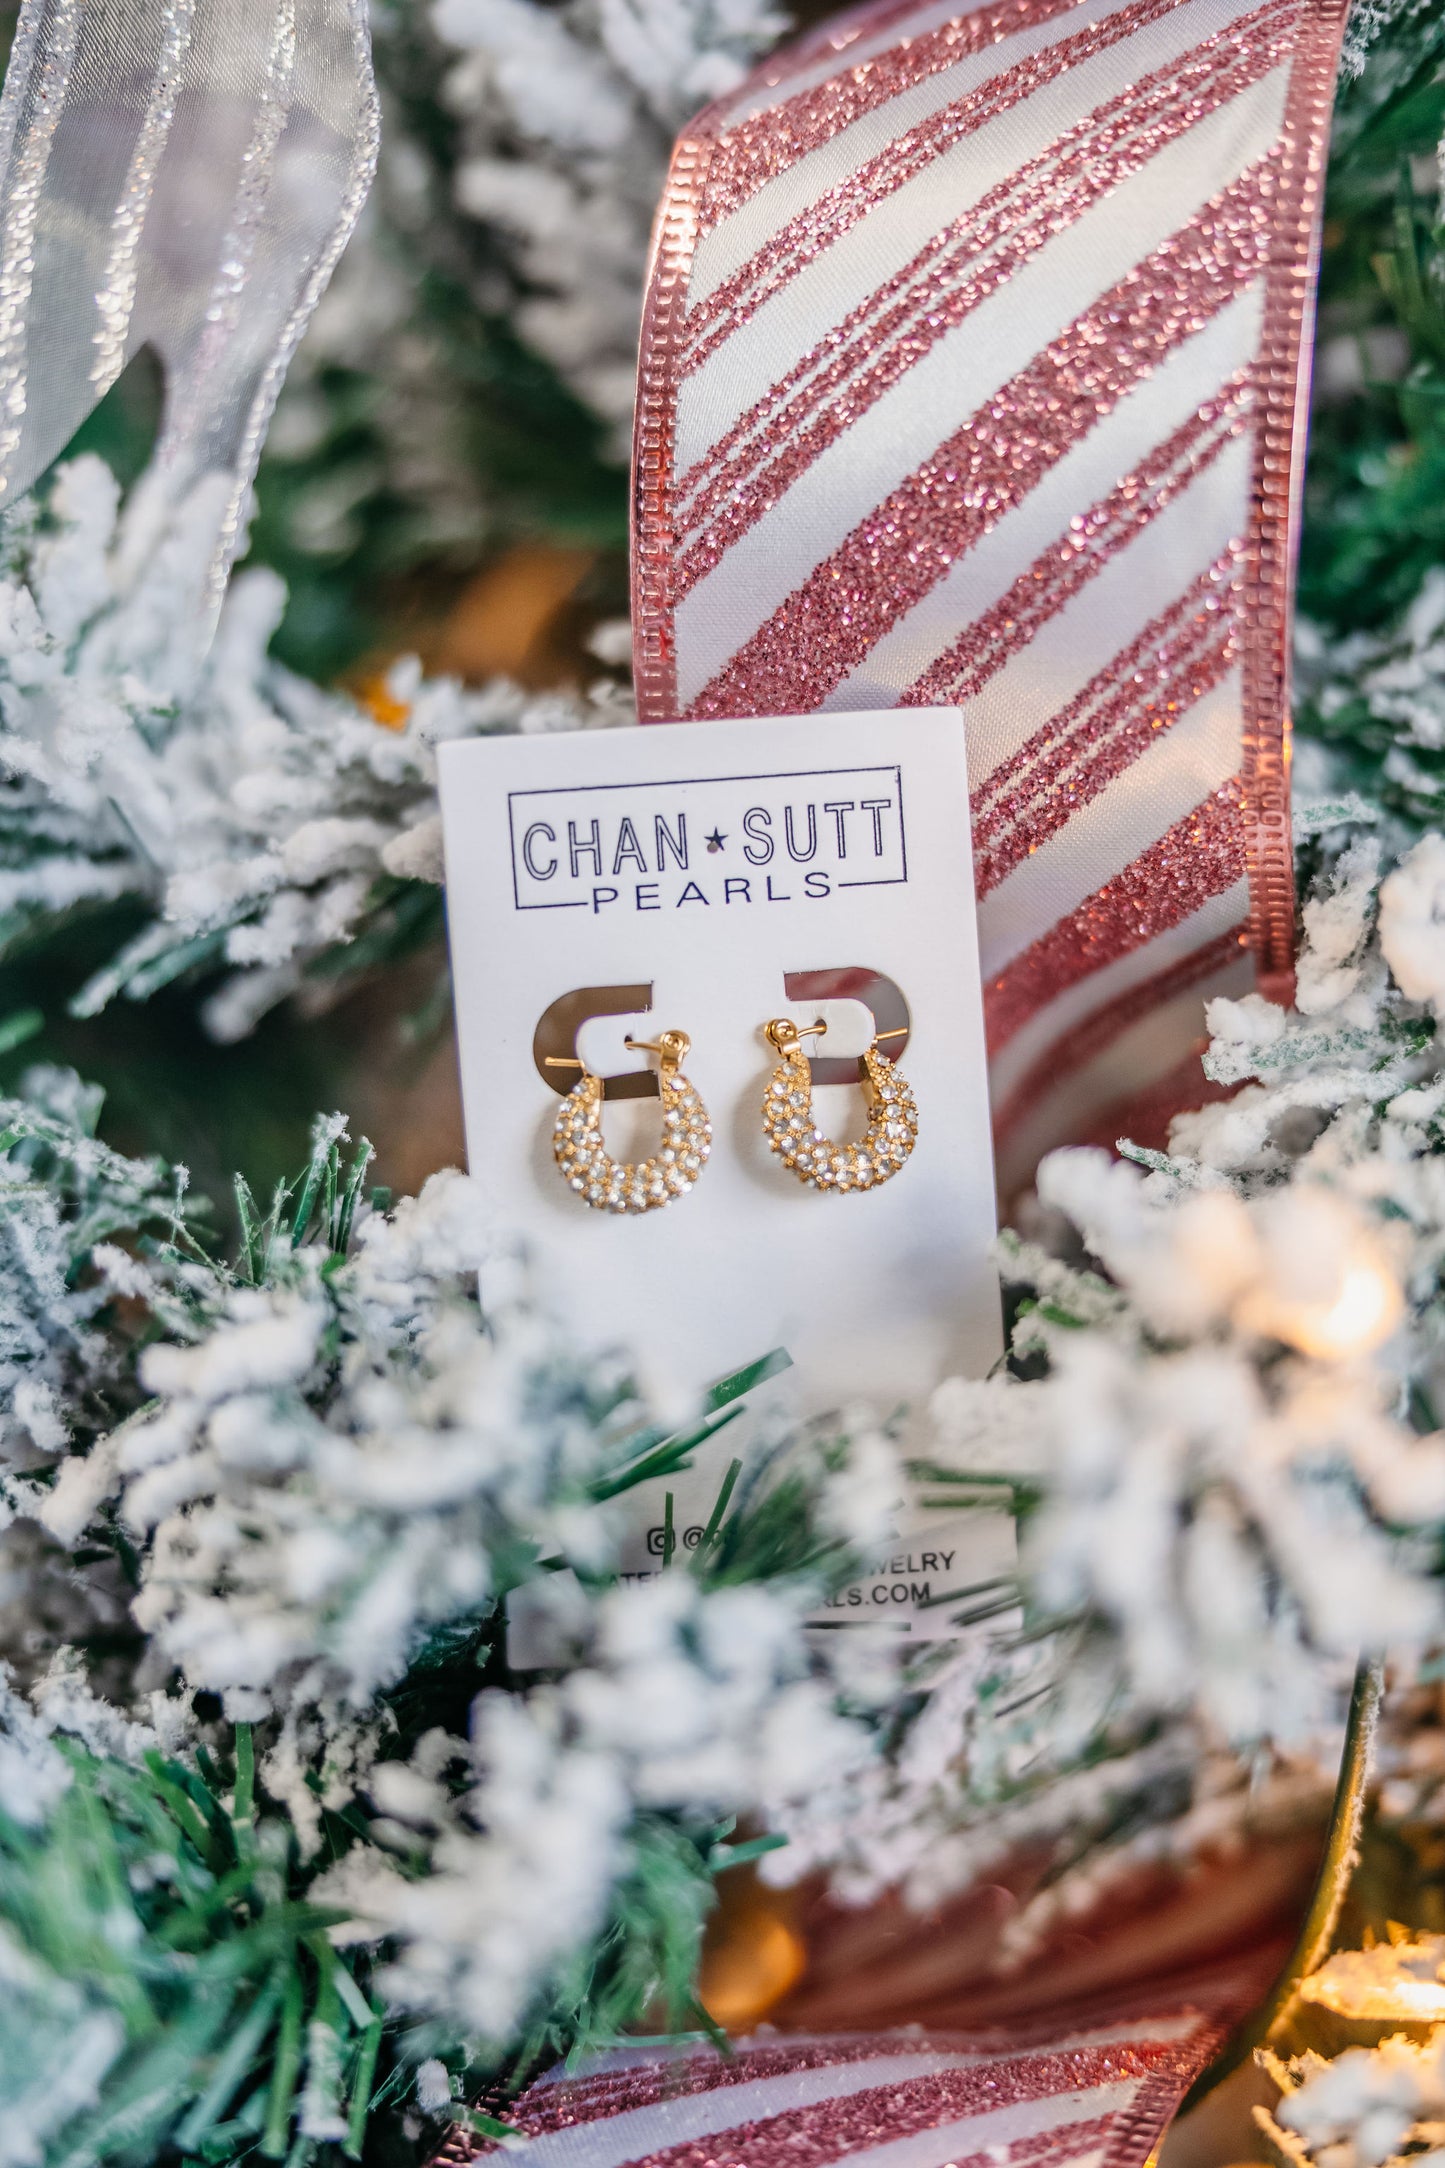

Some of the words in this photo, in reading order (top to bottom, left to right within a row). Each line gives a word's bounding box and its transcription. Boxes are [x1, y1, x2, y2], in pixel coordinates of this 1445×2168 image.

[523, 814, 689, 881] CHAN
[743, 799, 892, 866] SUTT
[593, 871, 831, 914] PEARLS
[868, 1550, 956, 1576] WELRY
[824, 1581, 931, 1608] LS.COM
